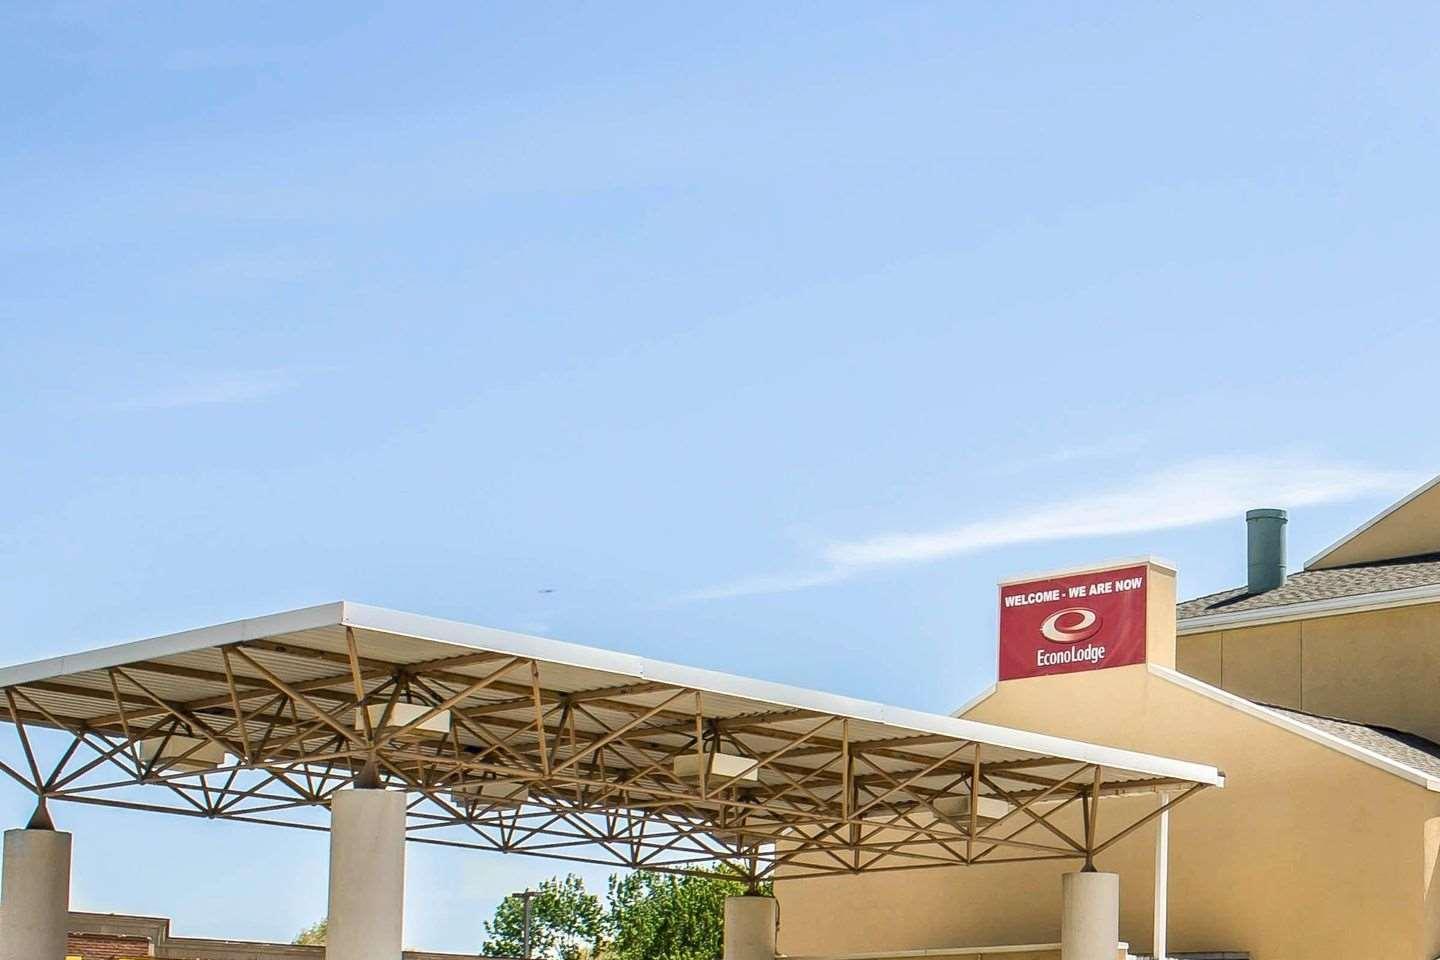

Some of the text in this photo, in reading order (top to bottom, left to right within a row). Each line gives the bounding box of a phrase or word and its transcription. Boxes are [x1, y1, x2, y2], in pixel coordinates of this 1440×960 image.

[1005, 590, 1060, 607] WELCOME
[1068, 586, 1086, 599] WE
[1089, 582, 1112, 596] ARE
[1115, 577, 1143, 592] NOW
[1037, 643, 1105, 666] EconoLodge
